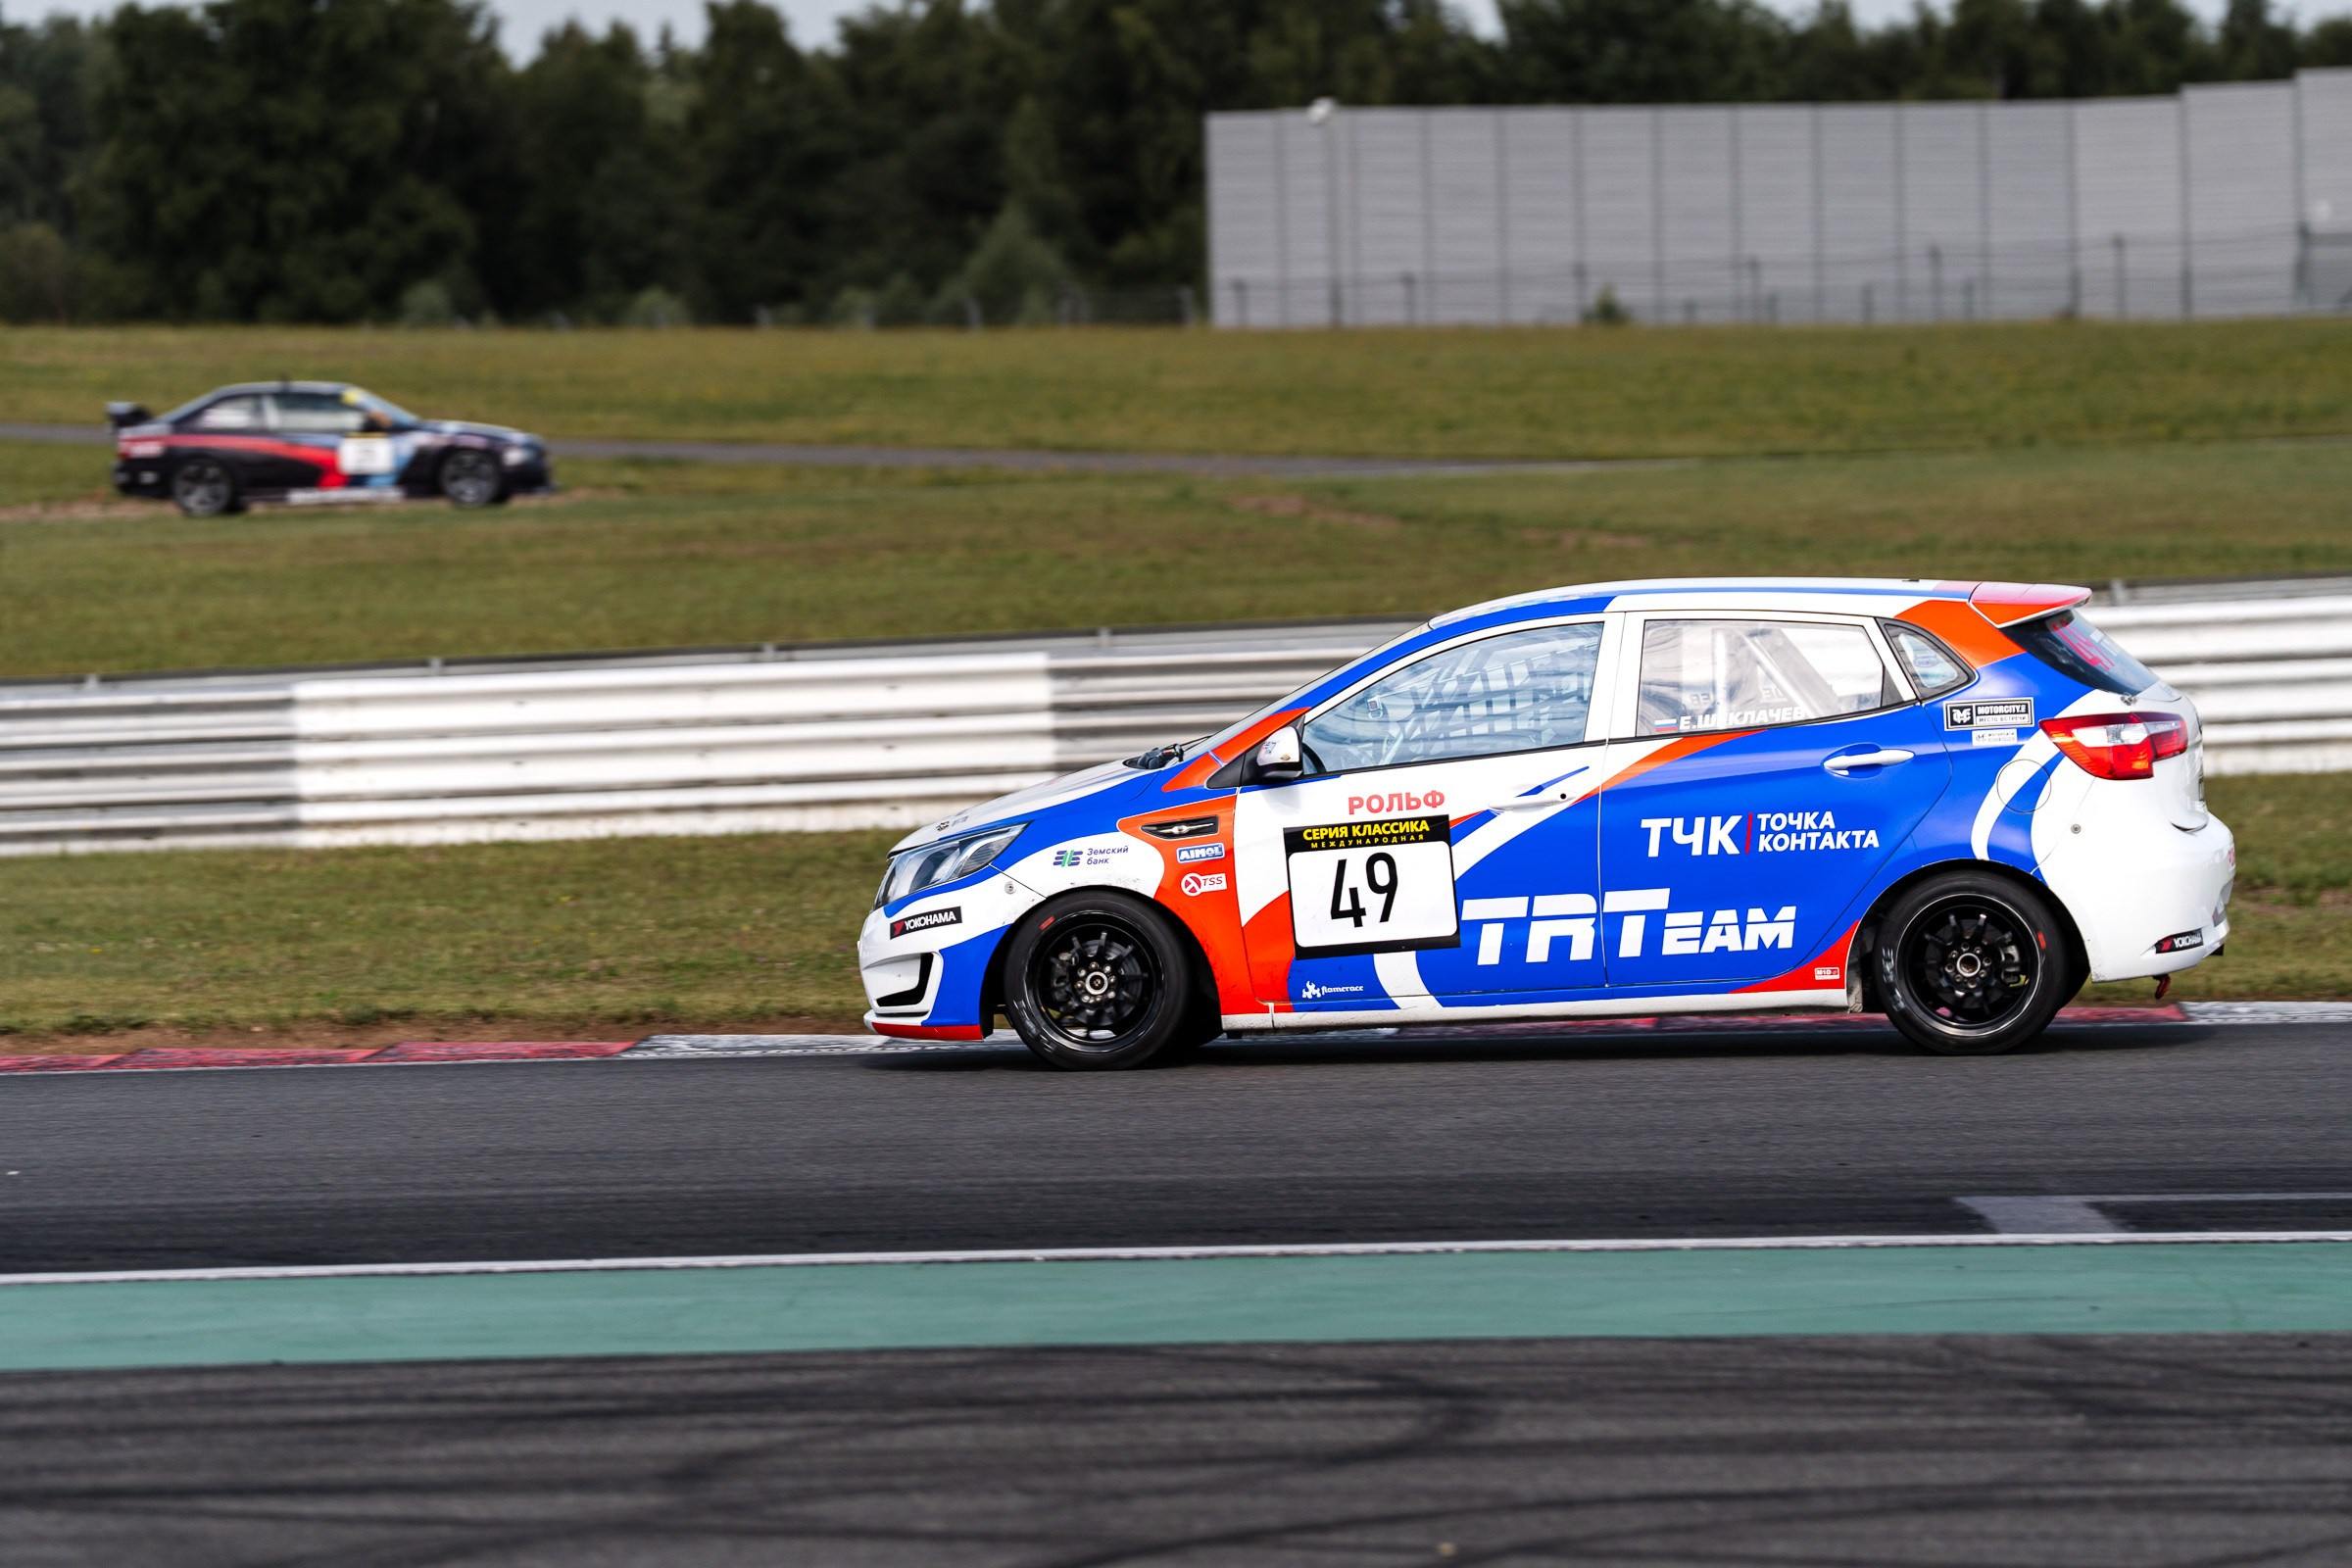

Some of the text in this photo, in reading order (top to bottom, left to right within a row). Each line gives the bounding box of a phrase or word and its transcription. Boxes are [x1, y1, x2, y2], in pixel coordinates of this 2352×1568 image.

[1679, 707, 1804, 731] Е.ШКЛАЧЕВ
[1348, 790, 1446, 815] РОЛЬФ
[1302, 819, 1431, 841] СЕРИЯ КЛАССИКА
[1757, 811, 1836, 832] ТОЧКА
[1311, 834, 1424, 849] МЕЖДУНАРОДНАЯ
[1641, 815, 1742, 858] ТЧК
[1758, 830, 1880, 853] КОНТАКТА
[1087, 845, 1129, 856] Земский
[1087, 857, 1109, 865] банк
[1179, 846, 1222, 860] AIMOL
[1201, 876, 1223, 887] TSS
[1330, 852, 1398, 928] 49
[905, 910, 956, 930] YOKOHAMA
